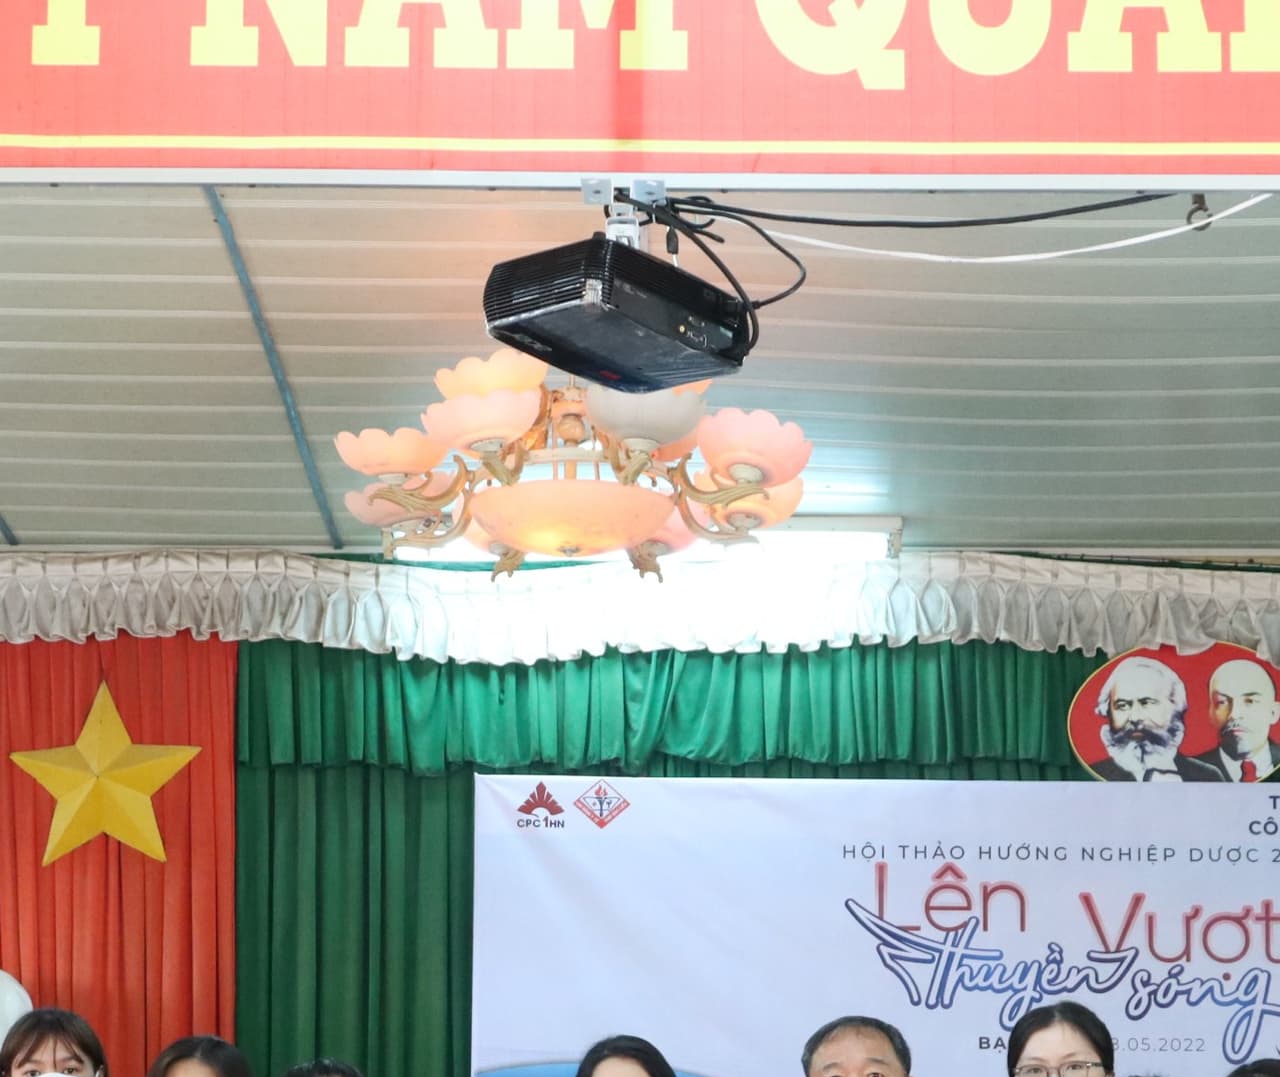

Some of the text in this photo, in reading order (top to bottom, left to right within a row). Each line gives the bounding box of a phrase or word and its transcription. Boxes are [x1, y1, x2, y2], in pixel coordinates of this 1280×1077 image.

[843, 841, 885, 862] HỘI
[898, 841, 965, 860] THẢO
[978, 843, 1067, 861] HƯỚNG
[1081, 844, 1176, 865] NGHIỆP
[1189, 845, 1259, 866] DƯỢC
[875, 861, 1028, 933] Lên
[979, 1037, 1007, 1053] BẠ
